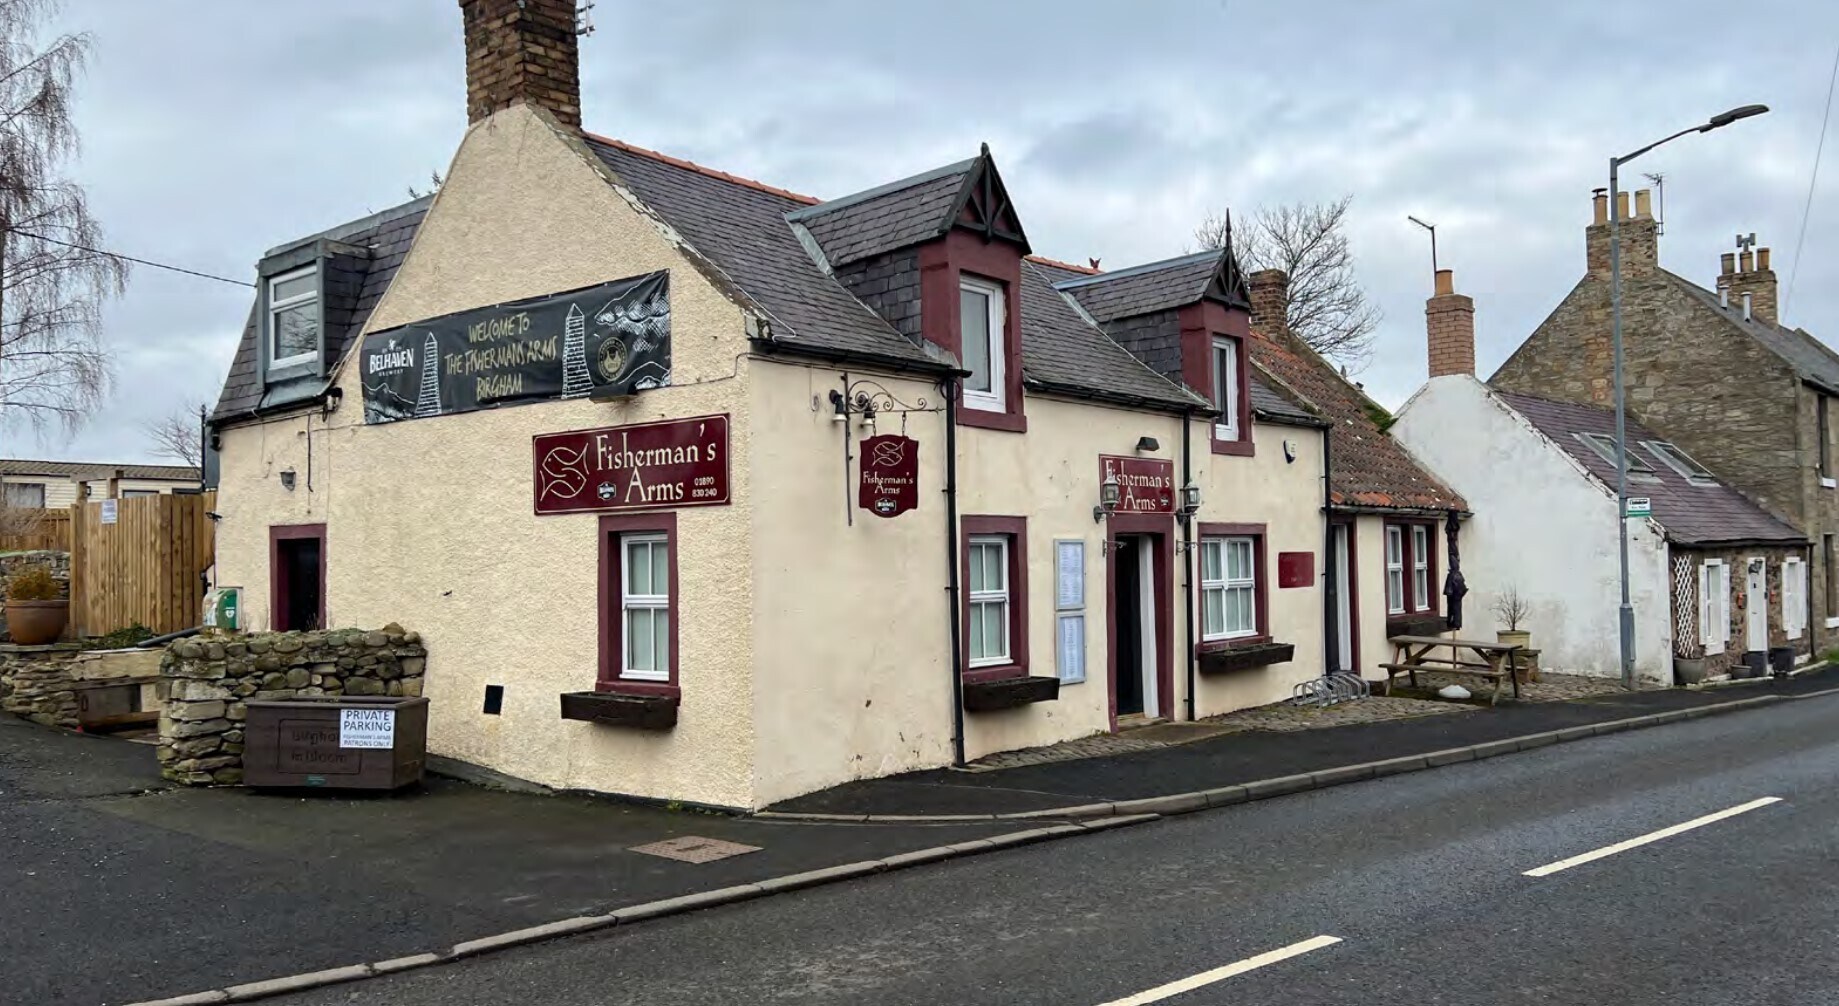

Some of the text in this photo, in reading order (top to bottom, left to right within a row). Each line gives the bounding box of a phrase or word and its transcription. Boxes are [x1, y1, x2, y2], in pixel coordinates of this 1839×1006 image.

[468, 316, 515, 343] WELCOME
[369, 347, 414, 375] BELHAVEN
[444, 353, 463, 376] THE
[526, 335, 558, 364] ARMS
[476, 373, 522, 401] BIRGHAM
[595, 423, 717, 471] Fisherman's
[624, 466, 684, 503] Arms
[862, 470, 914, 485] Fisherman's
[874, 482, 901, 494] Arms
[1123, 486, 1156, 511] Arms
[343, 720, 392, 732] PARKING
[346, 710, 390, 721] PRIVATE
[292, 730, 339, 745] Birgha
